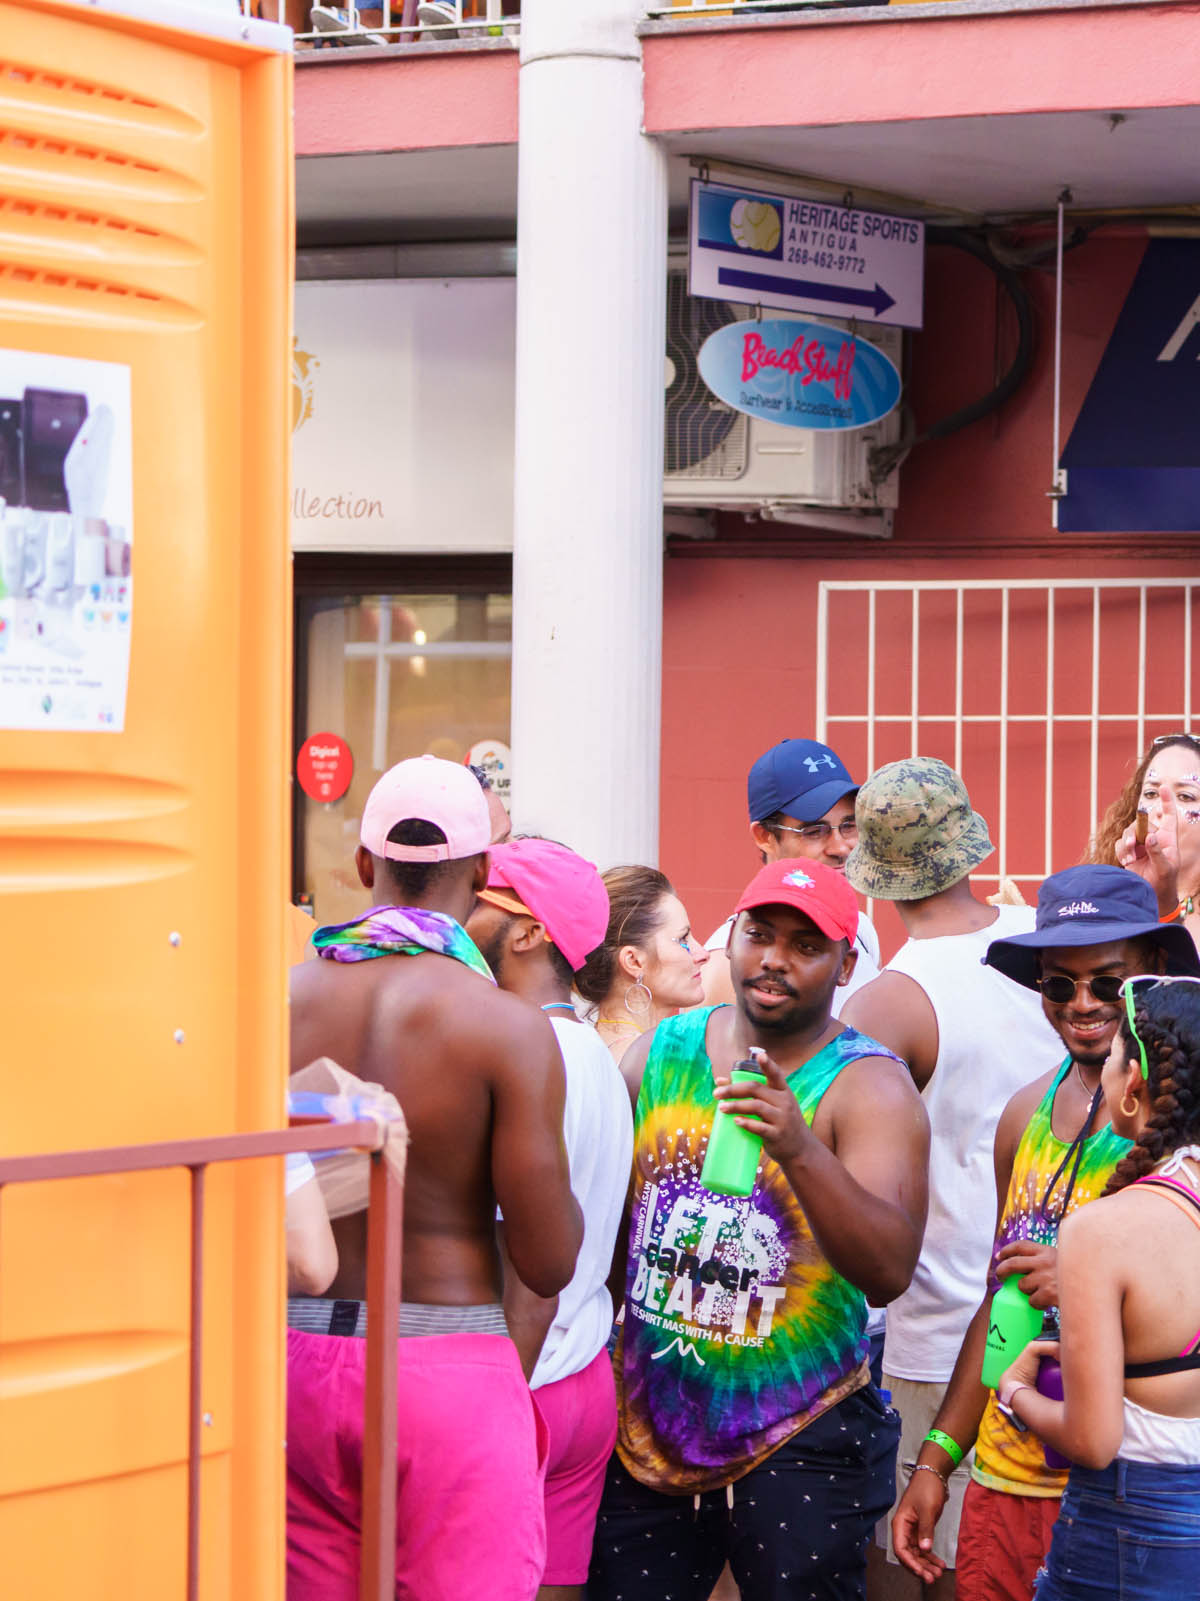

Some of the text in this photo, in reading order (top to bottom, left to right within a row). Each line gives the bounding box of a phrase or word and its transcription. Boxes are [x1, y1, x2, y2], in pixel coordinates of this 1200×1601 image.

[788, 227, 858, 252] ANTIGUA
[789, 203, 919, 244] HERITAGE SPORTS
[788, 247, 866, 274] 268-462-9772
[741, 332, 856, 400] Beach Stuff
[290, 488, 384, 519] llection
[641, 1180, 652, 1207] MYST
[633, 1206, 648, 1251] CARNIVAL
[647, 1242, 759, 1291] cancer
[638, 1309, 663, 1327] SHIRT
[662, 1319, 685, 1334] MAS
[685, 1326, 713, 1342] WITH
[713, 1331, 723, 1343] A
[724, 1334, 765, 1348] CAUSE
[731, 1285, 787, 1337] IT
